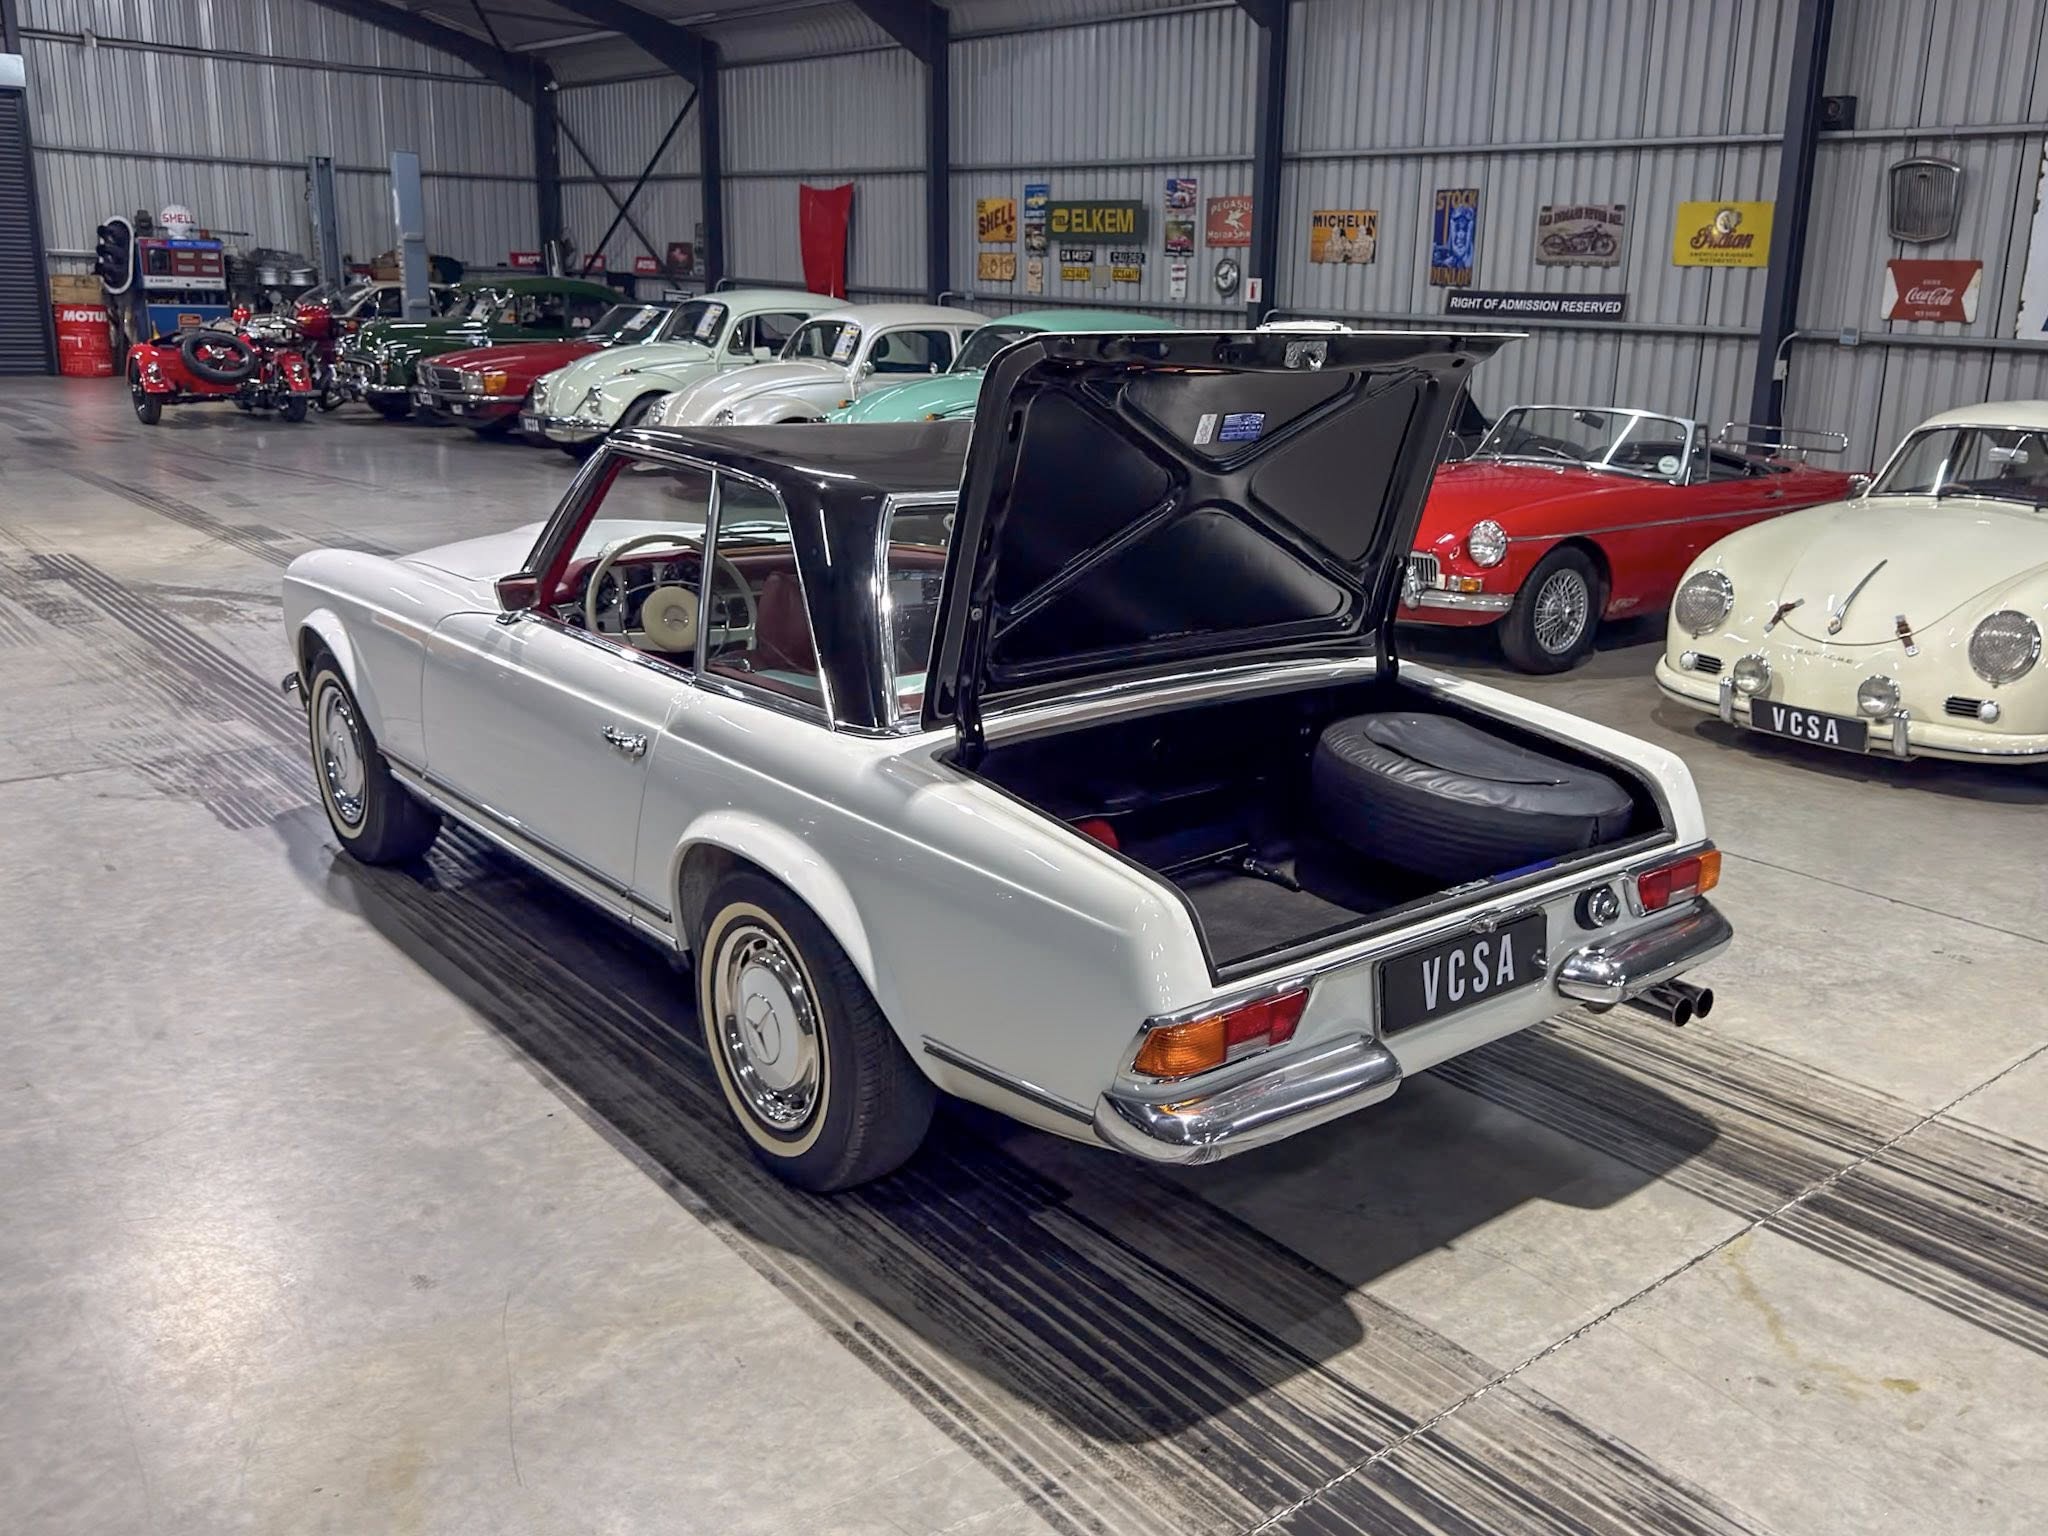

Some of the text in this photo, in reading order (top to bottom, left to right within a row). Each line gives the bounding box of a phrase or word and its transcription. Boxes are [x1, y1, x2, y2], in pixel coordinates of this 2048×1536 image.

[161, 213, 196, 224] SHELL
[979, 203, 1015, 235] SHELL
[1071, 208, 1134, 233] ELKEM
[1313, 214, 1376, 228] MICHELIN
[1450, 297, 1622, 314] RIGHT OF ADMISSION RESERVED
[1772, 706, 1839, 745] VCSA
[1422, 934, 1516, 1012] VCSA
